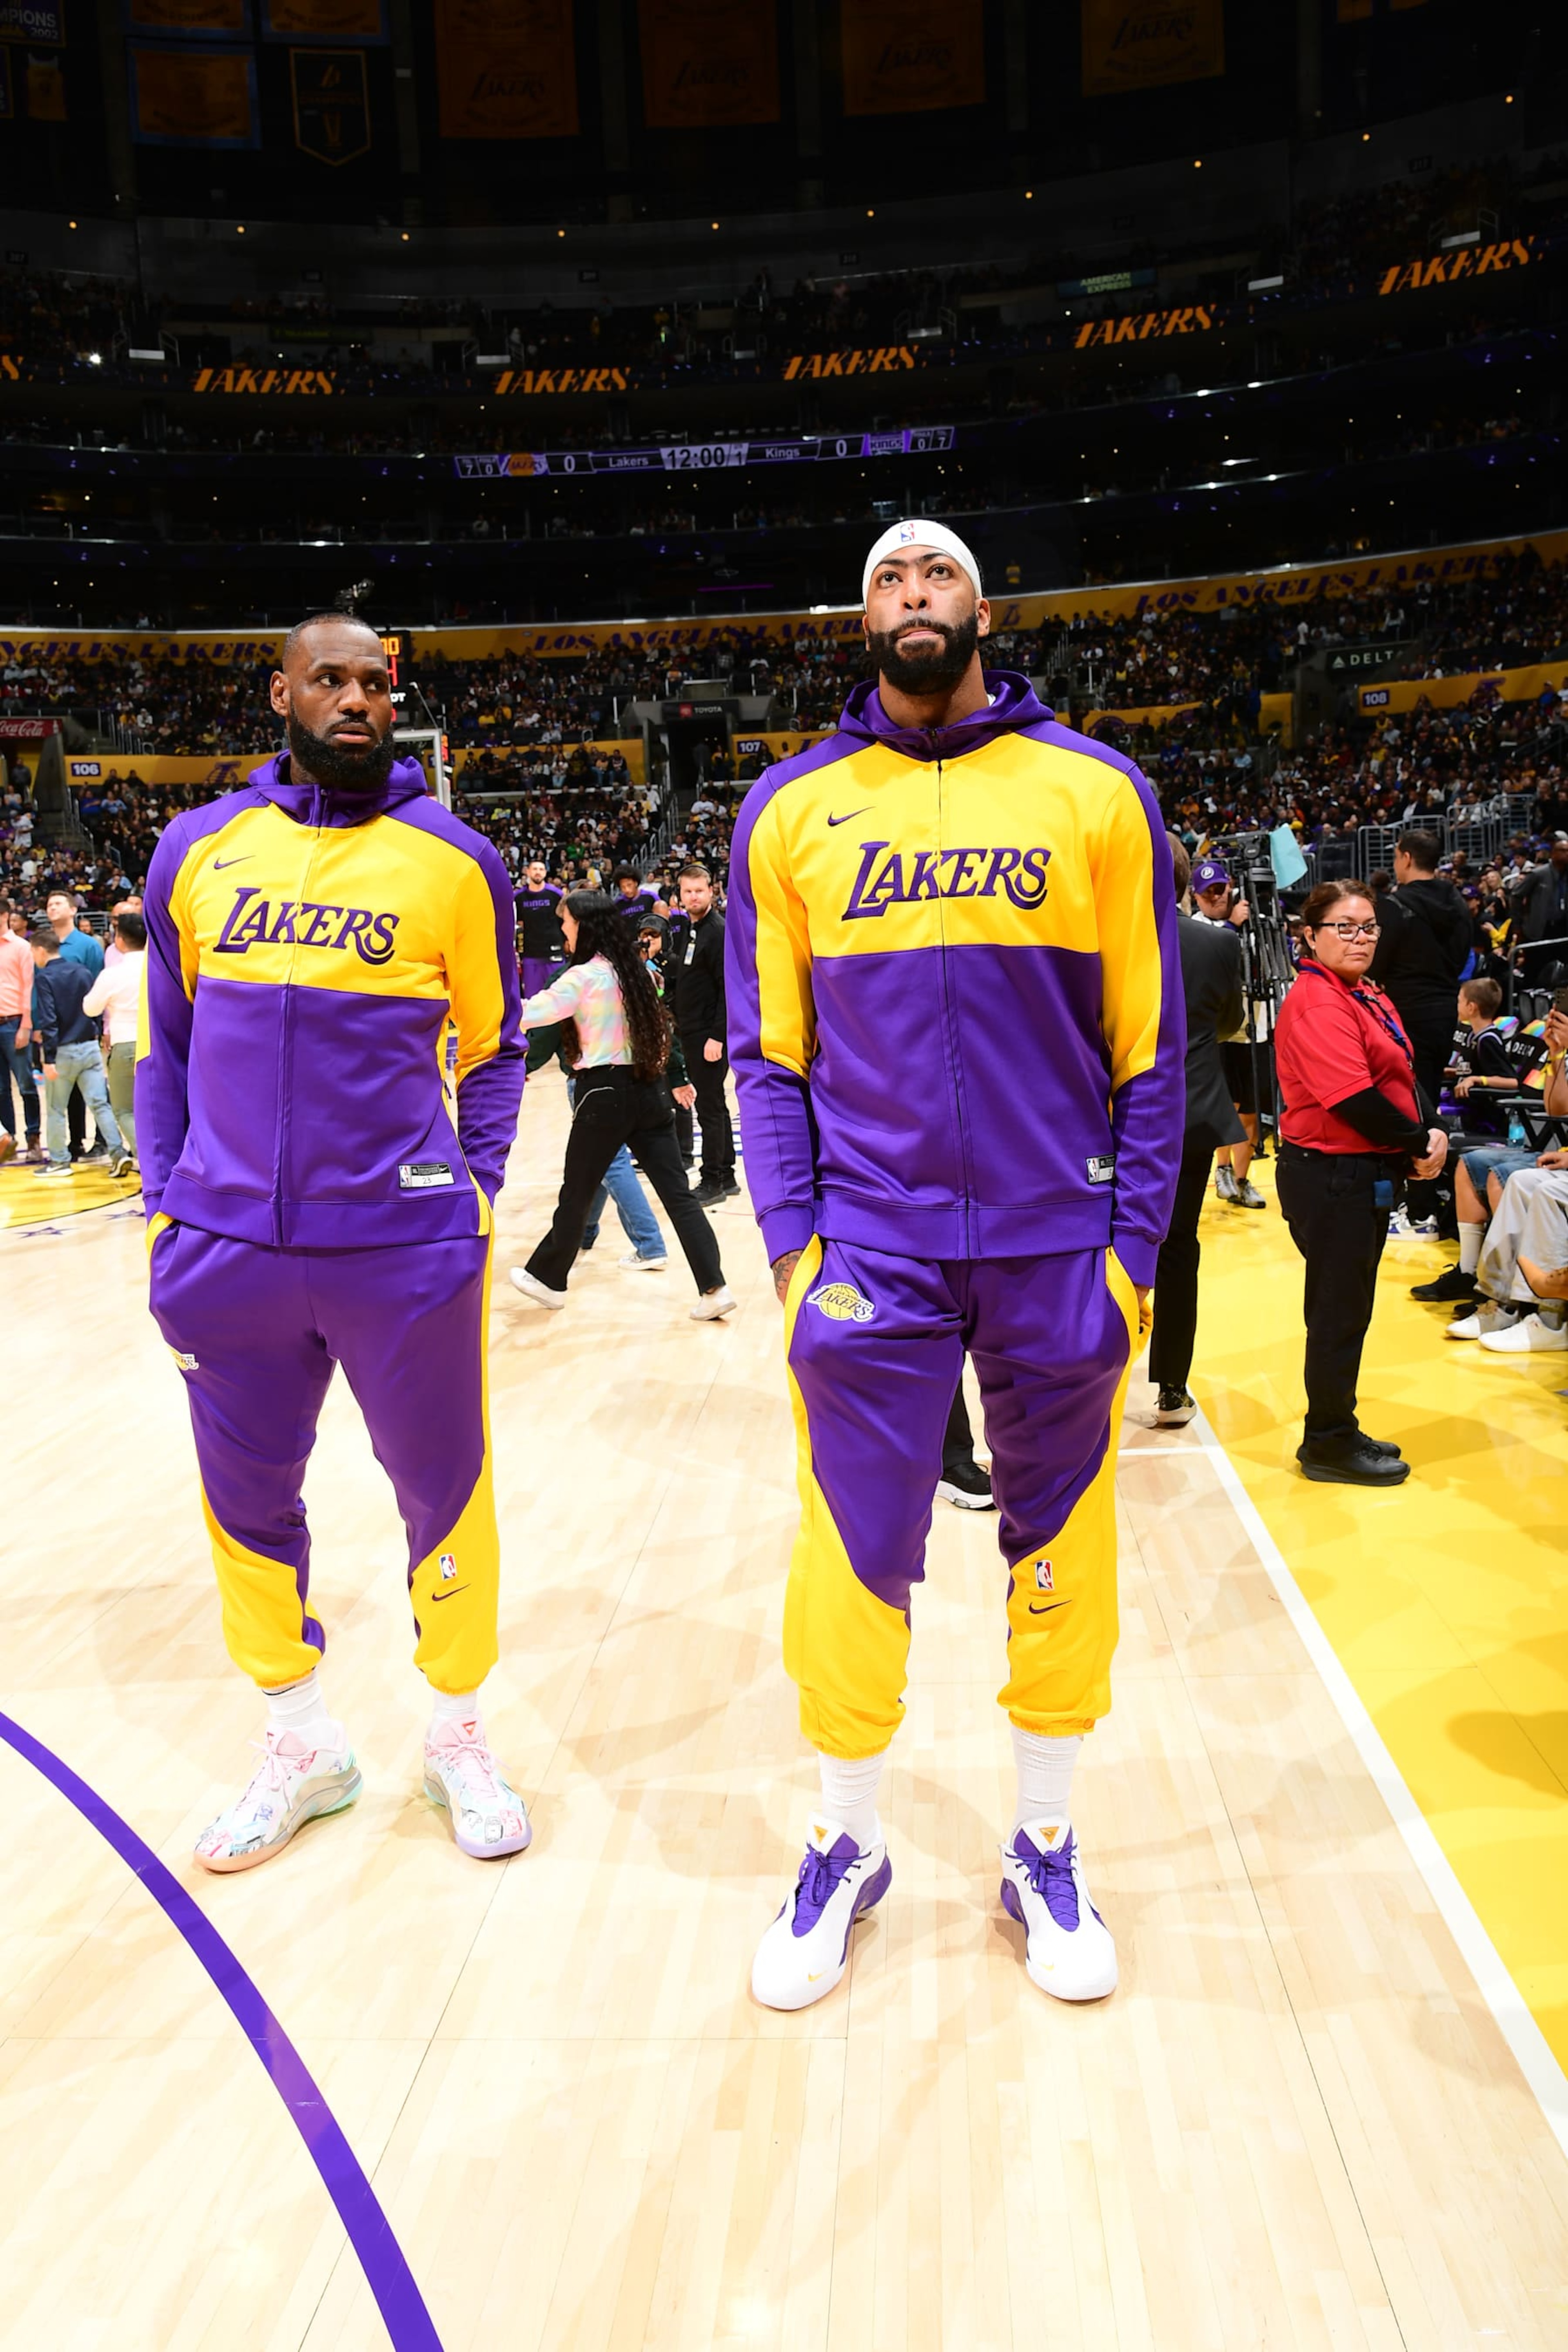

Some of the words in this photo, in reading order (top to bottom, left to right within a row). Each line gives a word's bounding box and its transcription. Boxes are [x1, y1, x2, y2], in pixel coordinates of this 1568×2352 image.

[0, 7, 56, 28] MPIONS
[1376, 234, 1537, 296] LAKERS
[1080, 272, 1131, 287] AMERICAN
[1087, 280, 1131, 294] EXPRESS
[1074, 303, 1217, 349] LAKERS
[781, 344, 920, 381] LAKERS
[190, 367, 337, 395] LAKERS
[492, 365, 632, 396] LAKERS
[836, 439, 847, 457] 0
[938, 437, 946, 448] 7
[608, 457, 649, 468] Lakers
[667, 447, 724, 468] 12:00
[736, 452, 742, 464] 1
[765, 448, 800, 460] Kings
[564, 455, 575, 472] 0
[535, 633, 595, 650] LOS
[755, 618, 862, 639] LAKER
[1350, 650, 1403, 666] DELT
[1365, 691, 1388, 706] 108
[694, 706, 723, 714] TOYOTA
[739, 742, 762, 753] 107
[73, 764, 100, 776] 106
[841, 841, 1052, 922] LAKERS
[523, 899, 550, 907] KINGS
[213, 887, 400, 965] LAKERS
[809, 1287, 871, 1320] LAKERS
